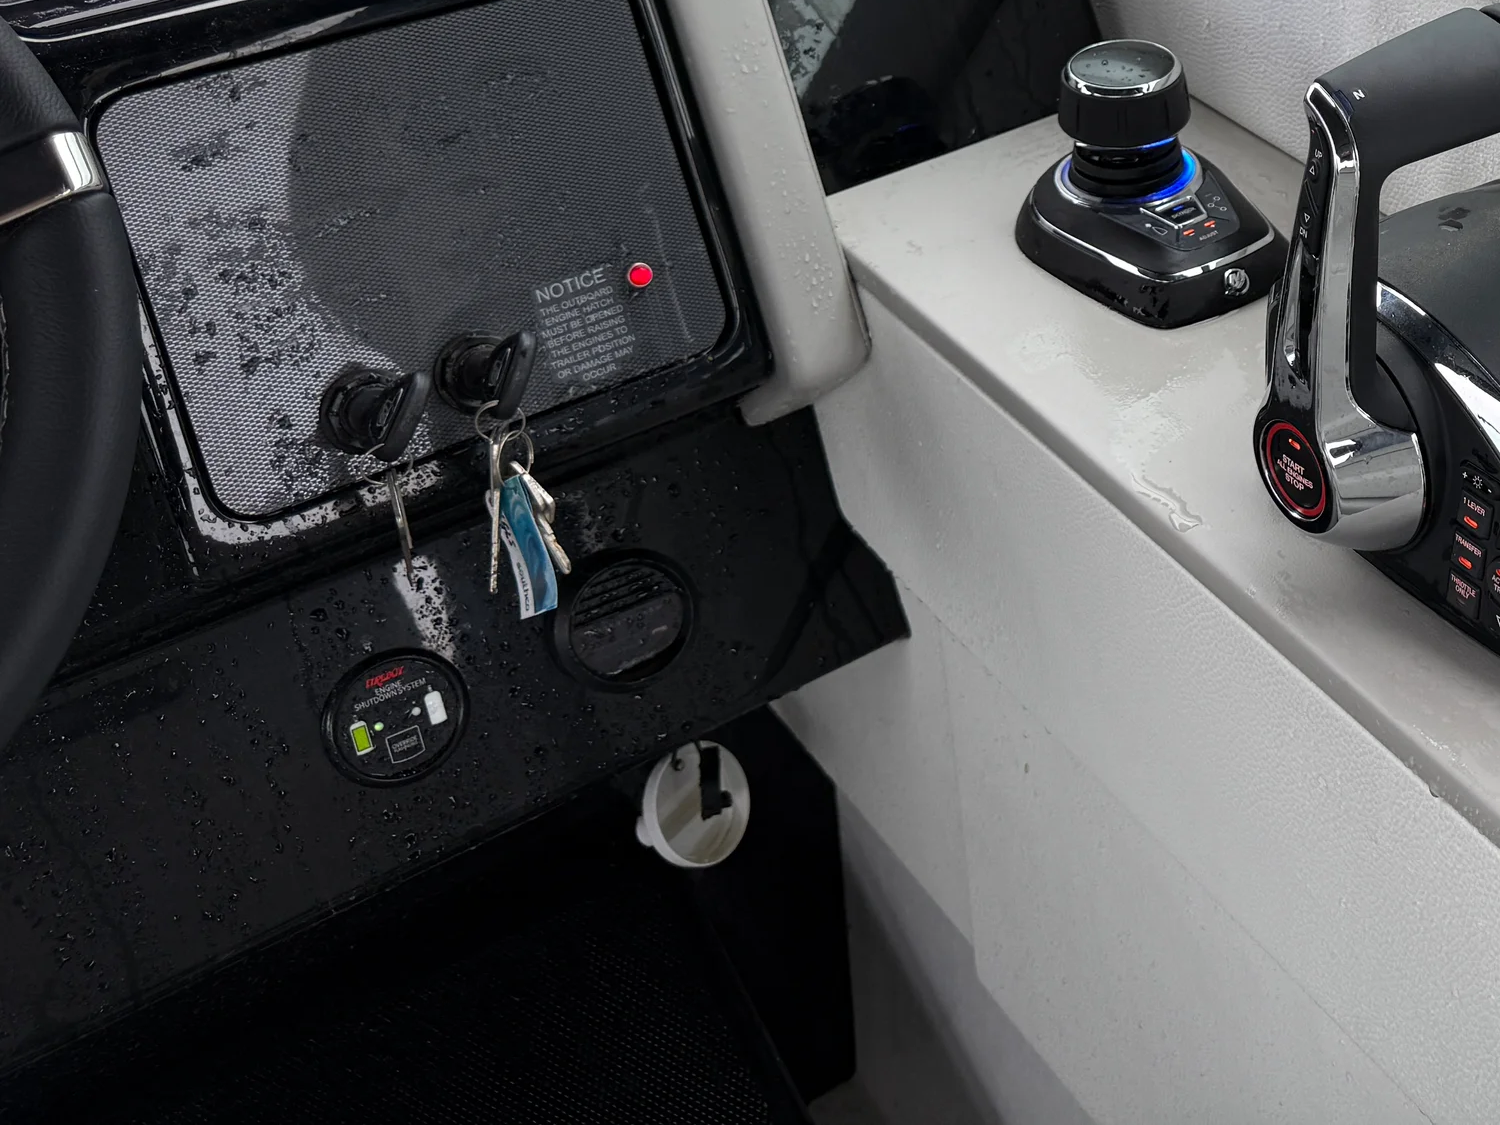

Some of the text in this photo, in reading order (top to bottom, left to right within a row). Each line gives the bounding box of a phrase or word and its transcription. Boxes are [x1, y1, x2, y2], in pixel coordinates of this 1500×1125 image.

[1352, 89, 1366, 101] N
[1314, 148, 1323, 160] UP
[1299, 226, 1309, 239] DN
[535, 267, 607, 303] NOTICE
[540, 285, 614, 317] THE OUTBOARD
[544, 297, 615, 326] ENGINE HATCH
[541, 304, 624, 339] MUST BE OPENED
[548, 315, 626, 349] BEFORE RAISING
[551, 325, 628, 358] THE ENGINES TO
[551, 334, 636, 369] TRAILER POSITION
[557, 345, 634, 379] OR DAMAGE MAY
[582, 363, 617, 382] OCCUR
[1277, 459, 1314, 489] ALL ENGINES
[1282, 454, 1305, 475] START
[1285, 473, 1305, 491] STOP
[1467, 499, 1486, 517] LEVER
[1455, 533, 1482, 558] TRANSFER
[1451, 574, 1476, 598] THROTTLE
[1455, 585, 1472, 600] ONLY
[354, 677, 427, 712] SHUTDOWN SYSTEM
[374, 679, 403, 695] ENGINE
